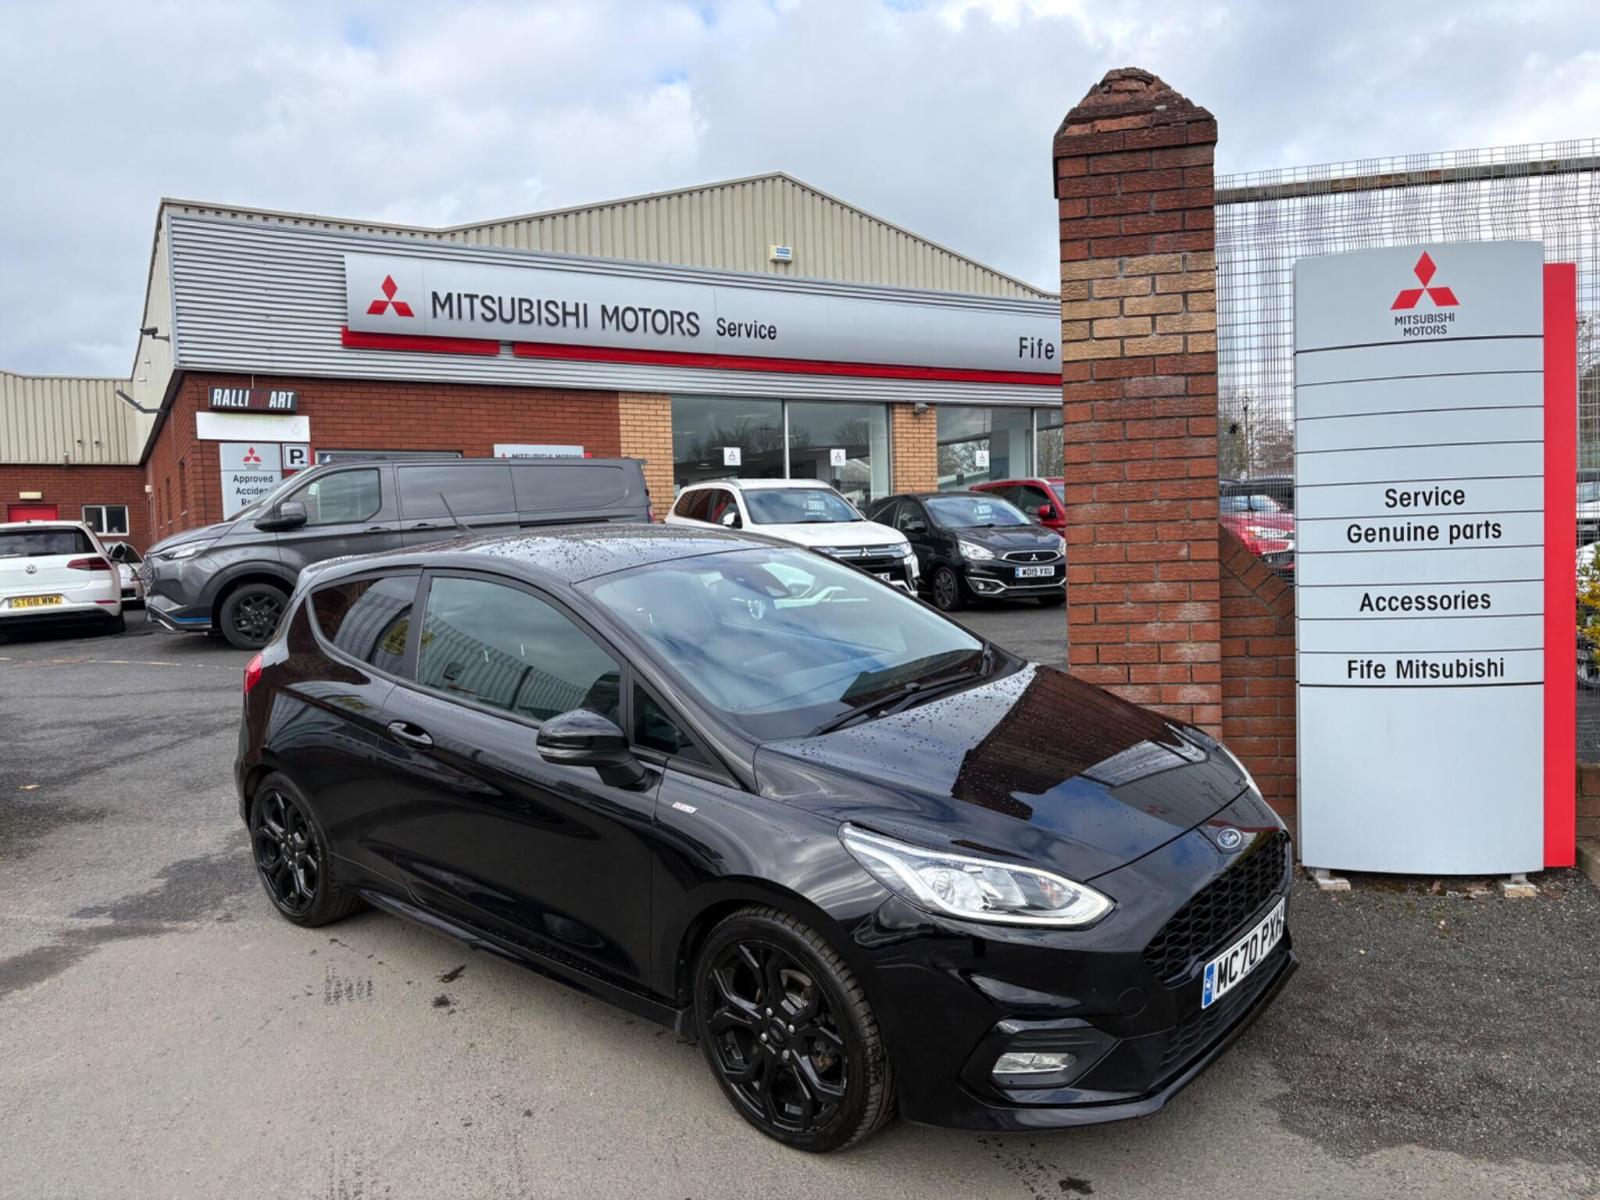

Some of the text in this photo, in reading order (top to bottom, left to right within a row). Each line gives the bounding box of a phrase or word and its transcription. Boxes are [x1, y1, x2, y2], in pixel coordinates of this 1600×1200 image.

[431, 291, 777, 340] MITSUBISHI MOTORS Service
[1394, 312, 1455, 326] MITSUBISHI
[1403, 324, 1447, 336] MOTORS
[1019, 337, 1055, 360] Fife
[212, 388, 294, 409] RALLI ART
[290, 449, 304, 465] P
[233, 474, 273, 484] Approved
[1385, 486, 1465, 508] Service
[1347, 520, 1502, 545] Genuine parts
[1359, 590, 1491, 612] Accessories
[1347, 657, 1505, 679] Fife Mitsubishi
[1217, 933, 1258, 994] MC70
